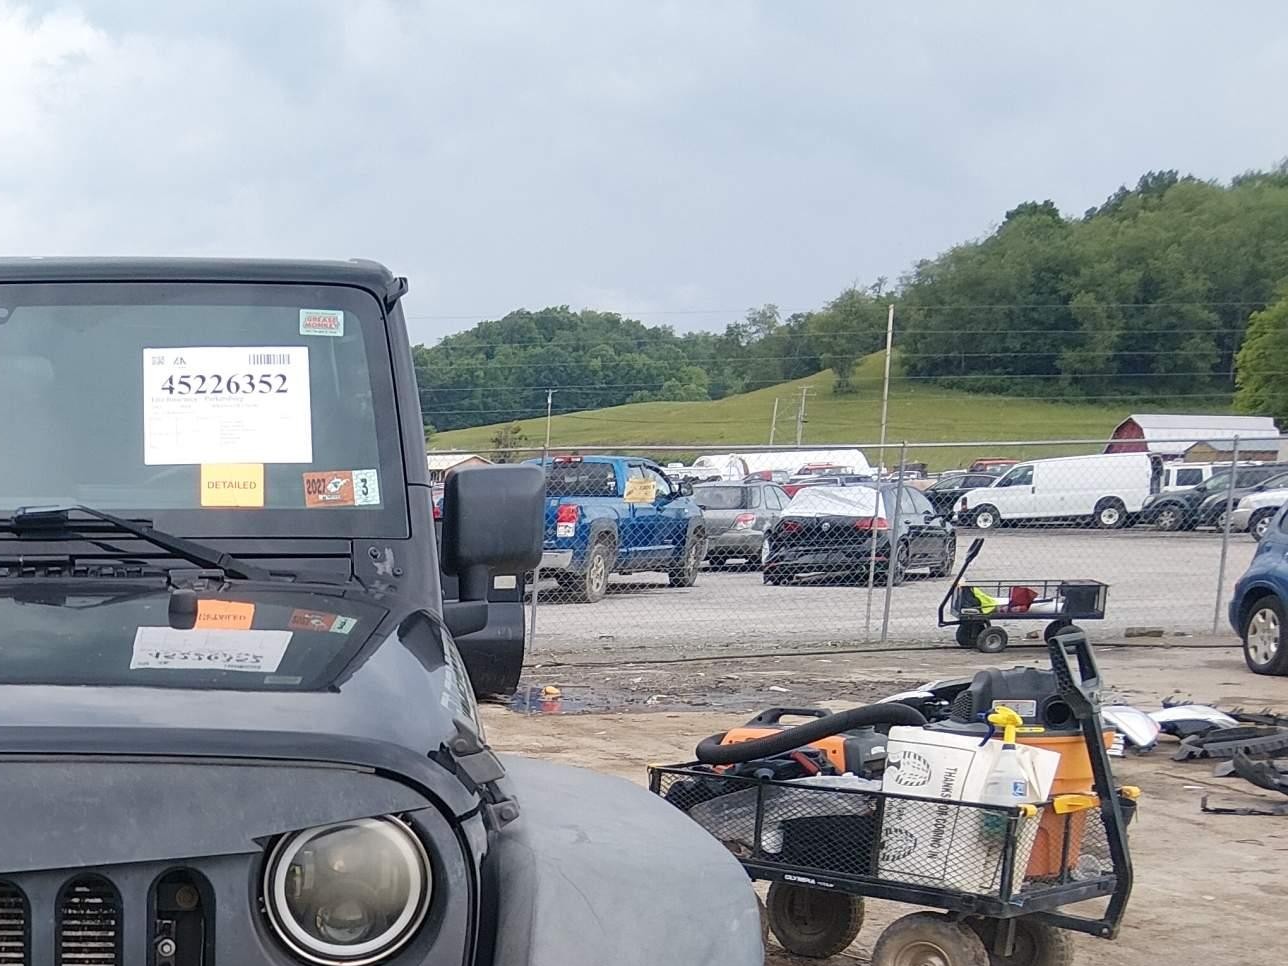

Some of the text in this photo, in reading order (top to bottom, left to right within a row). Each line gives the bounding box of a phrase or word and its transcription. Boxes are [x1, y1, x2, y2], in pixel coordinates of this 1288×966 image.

[161, 373, 289, 395] 45226352
[207, 480, 257, 490] DETAILED
[306, 478, 369, 496] 2027 3
[941, 767, 958, 799] THANKS
[929, 818, 946, 850] COMING
